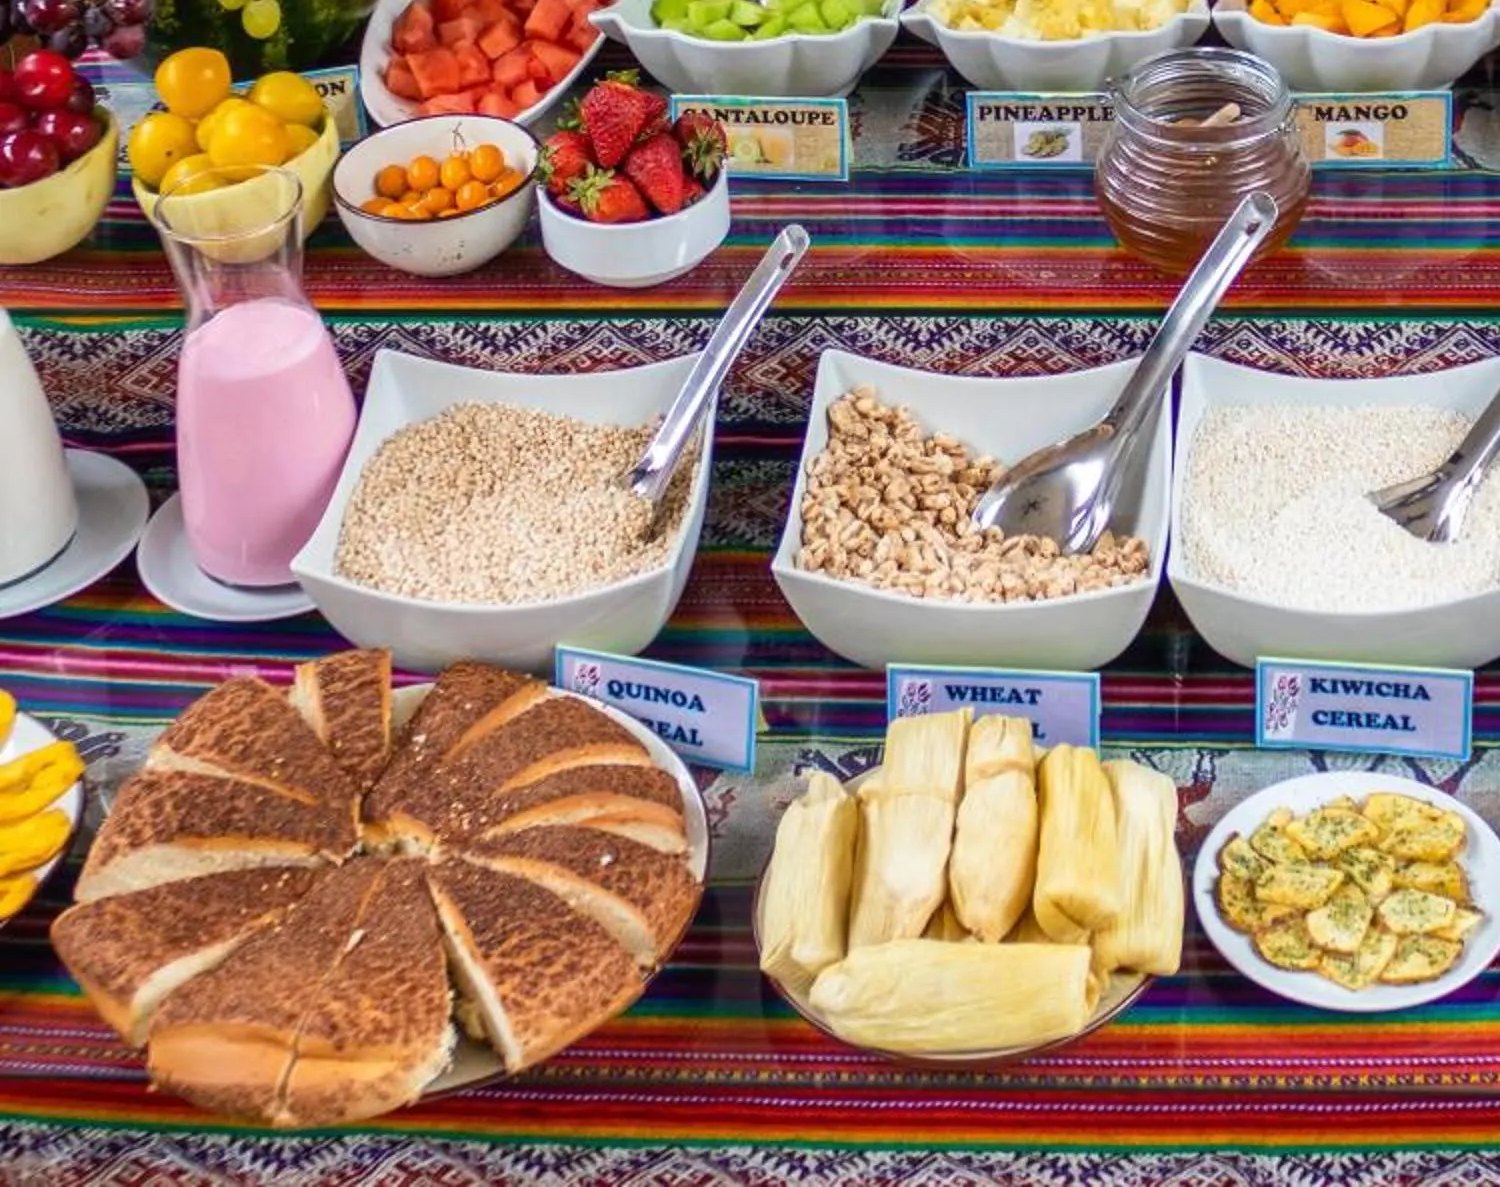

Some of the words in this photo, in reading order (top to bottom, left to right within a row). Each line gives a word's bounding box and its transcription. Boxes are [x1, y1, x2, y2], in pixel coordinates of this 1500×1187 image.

[977, 105, 1116, 122] PINEAPPLE
[1314, 104, 1409, 121] MANGO
[607, 679, 706, 713] QUINOA
[945, 684, 1043, 705] WHEAT
[1309, 677, 1431, 701] KIWICHA
[637, 717, 704, 747] EAL
[1311, 709, 1417, 732] CEREAL
